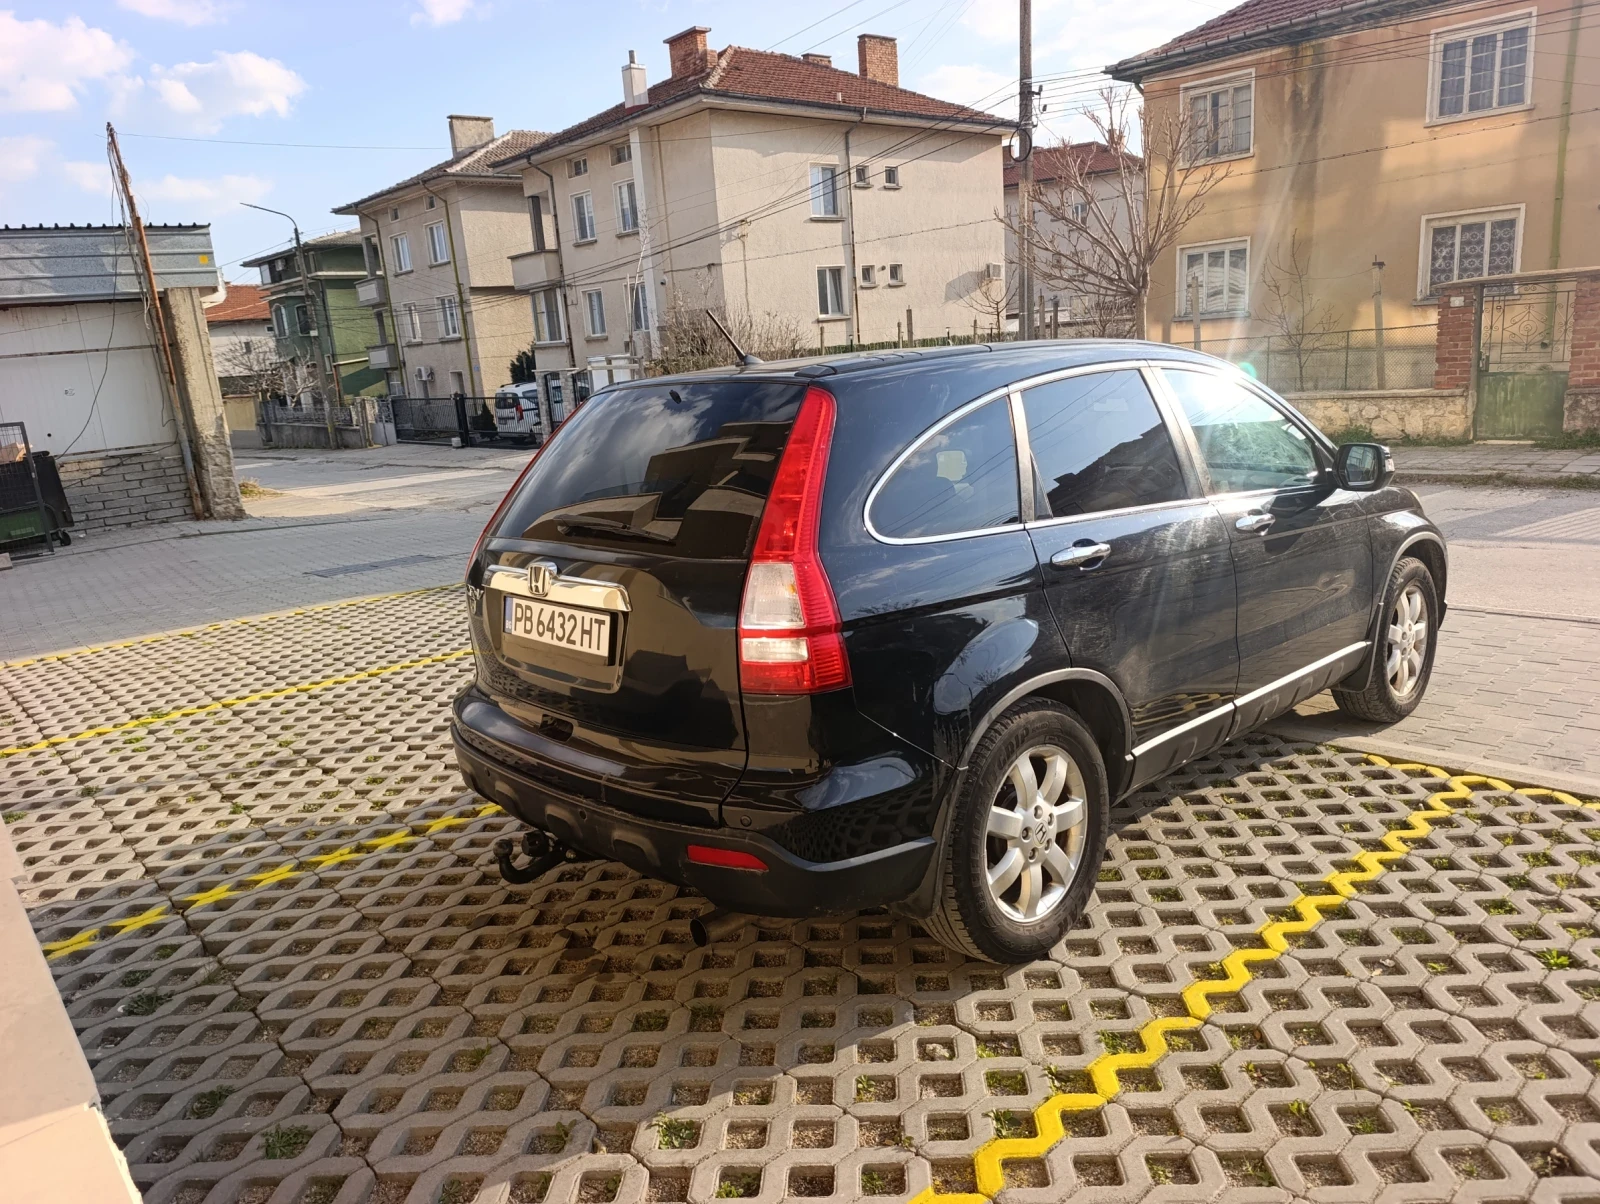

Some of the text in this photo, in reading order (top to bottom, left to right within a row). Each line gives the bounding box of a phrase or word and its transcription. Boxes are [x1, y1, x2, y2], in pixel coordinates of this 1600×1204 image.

[514, 602, 606, 651] PB 6432 HT
